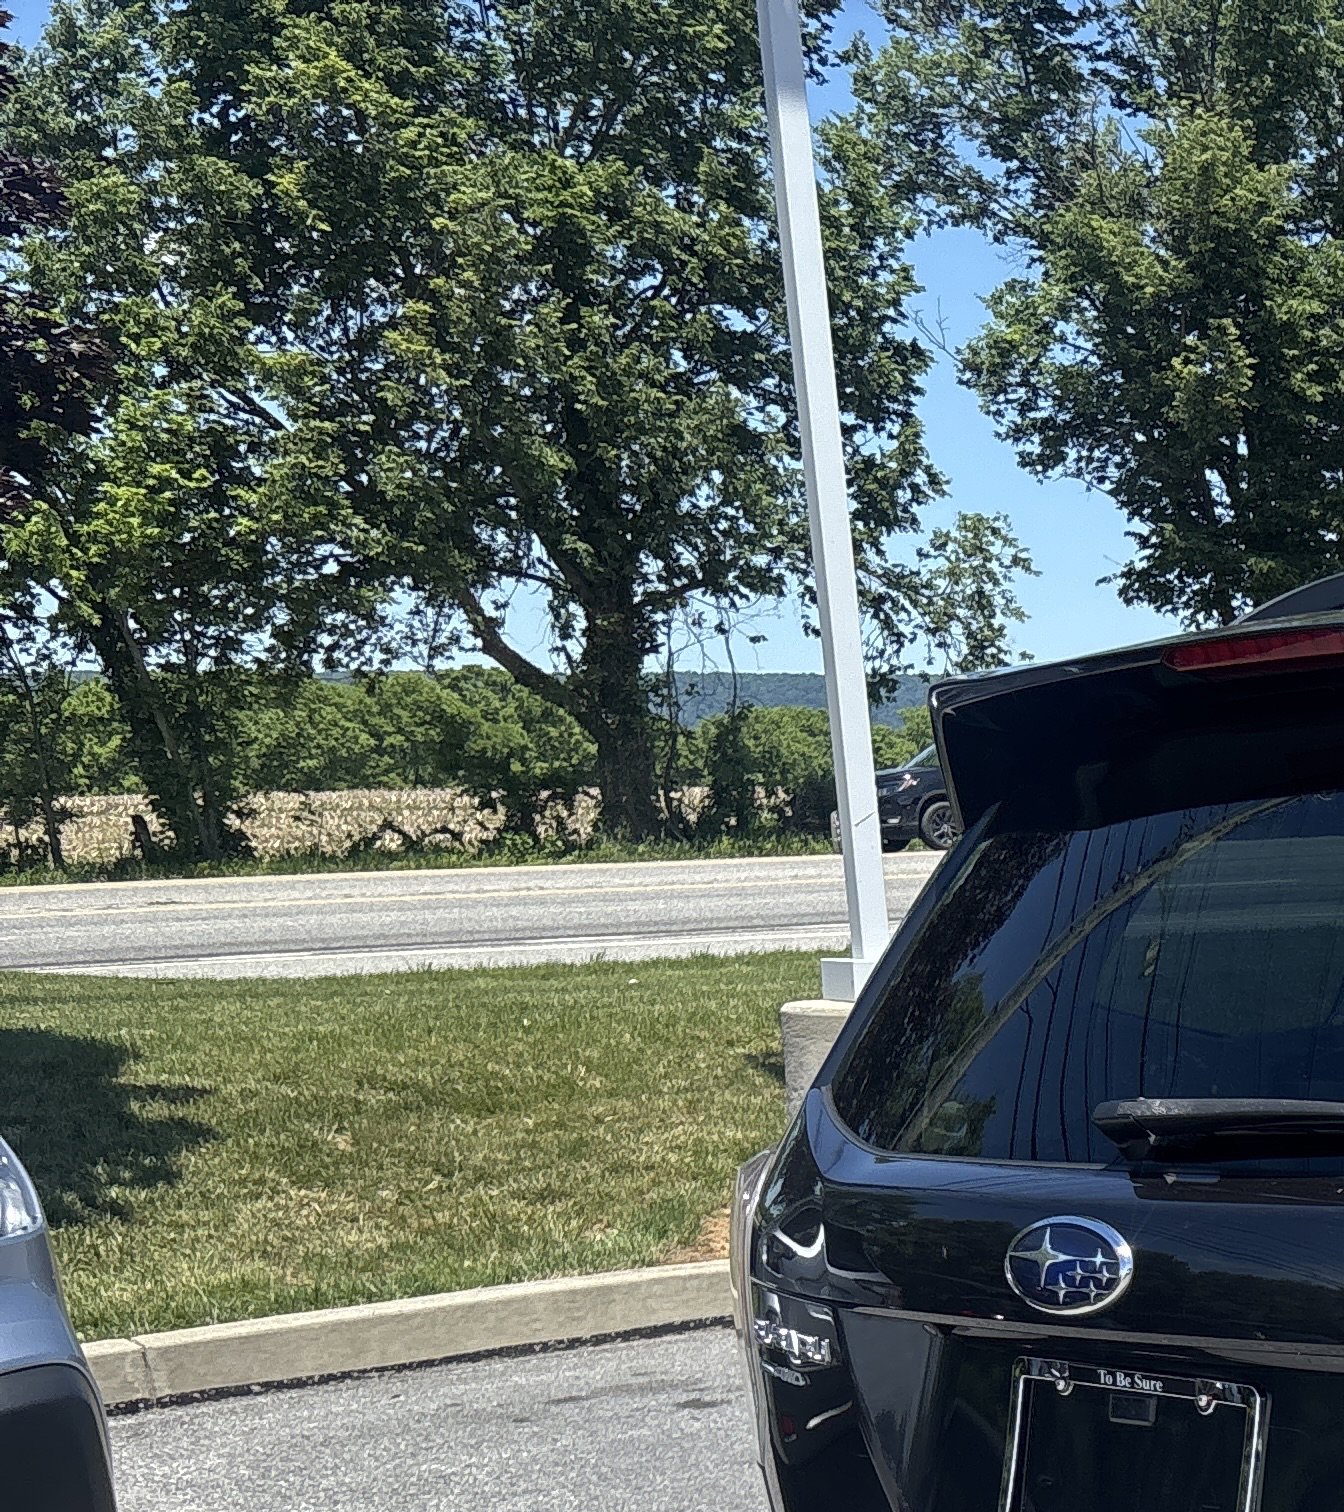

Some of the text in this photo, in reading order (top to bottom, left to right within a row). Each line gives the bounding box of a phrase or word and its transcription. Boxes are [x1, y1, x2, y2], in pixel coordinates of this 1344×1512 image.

[1096, 1368, 1164, 1392] To Be Sure
